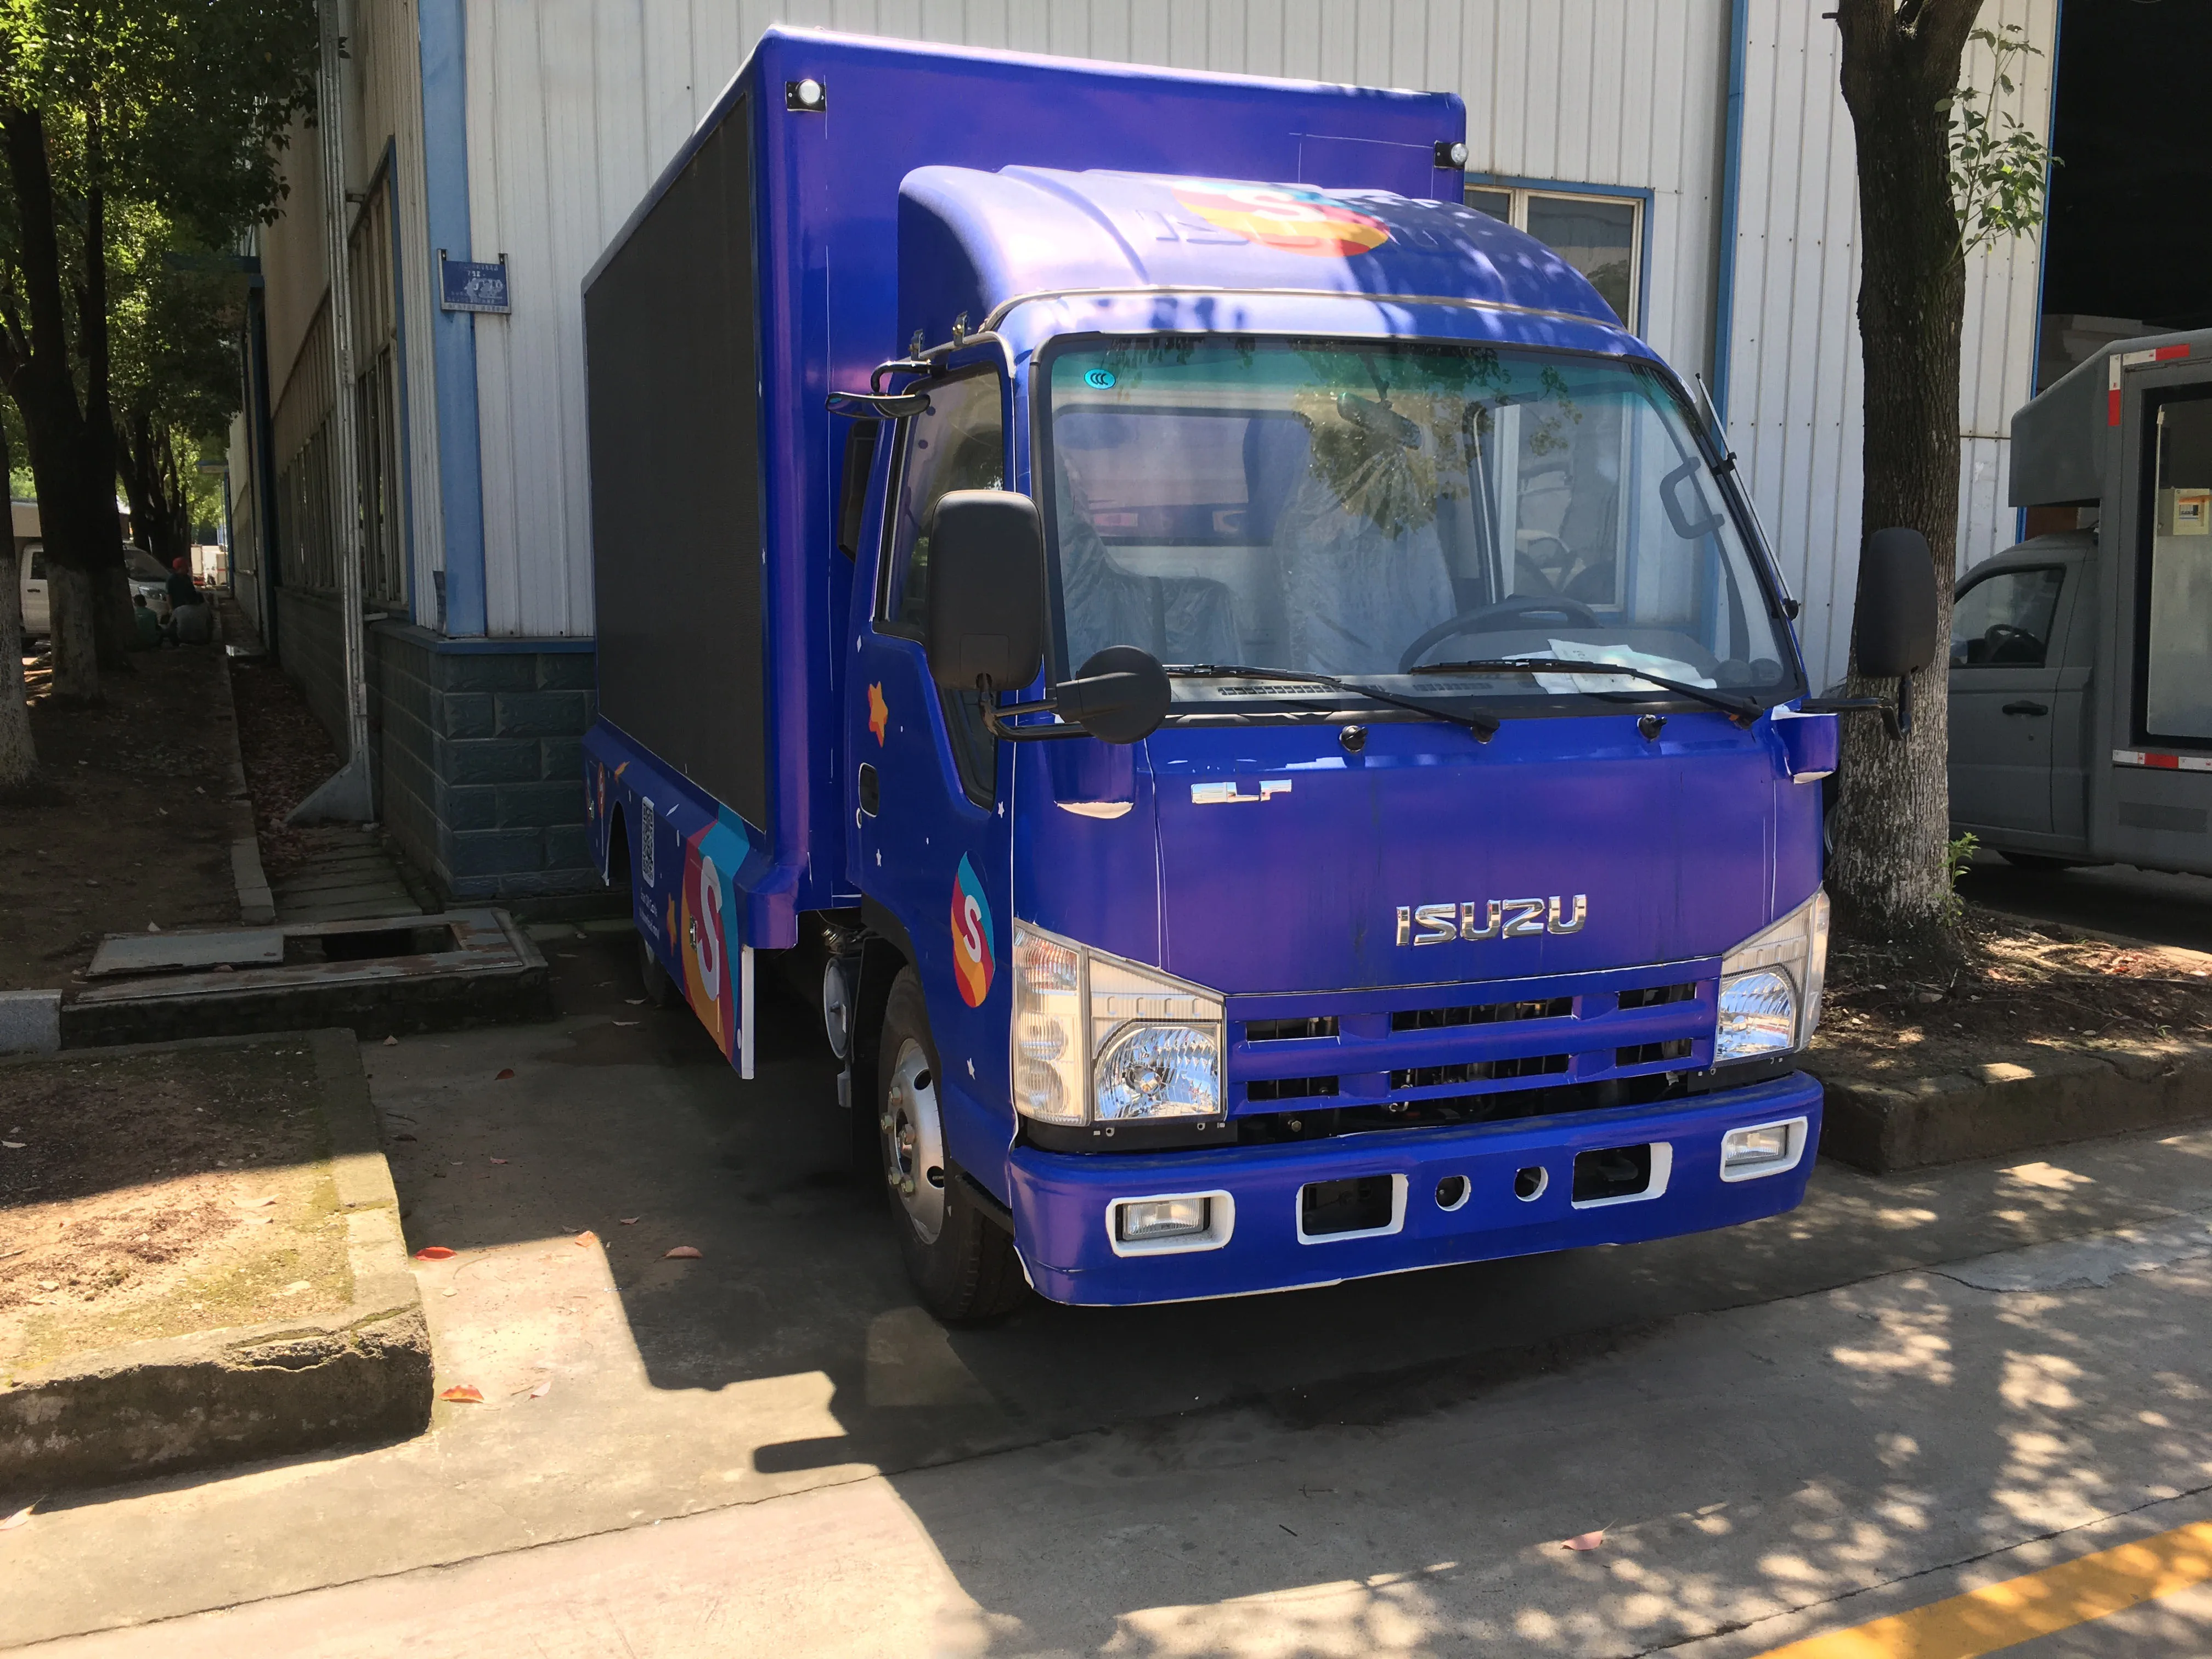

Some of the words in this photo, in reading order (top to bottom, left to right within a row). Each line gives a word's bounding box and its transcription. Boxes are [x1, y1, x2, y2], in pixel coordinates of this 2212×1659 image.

[1227, 189, 1327, 222] S
[1090, 373, 1109, 386] CCC
[697, 855, 723, 1001] S
[963, 894, 982, 963] S
[1396, 894, 1587, 946] ISUZU
